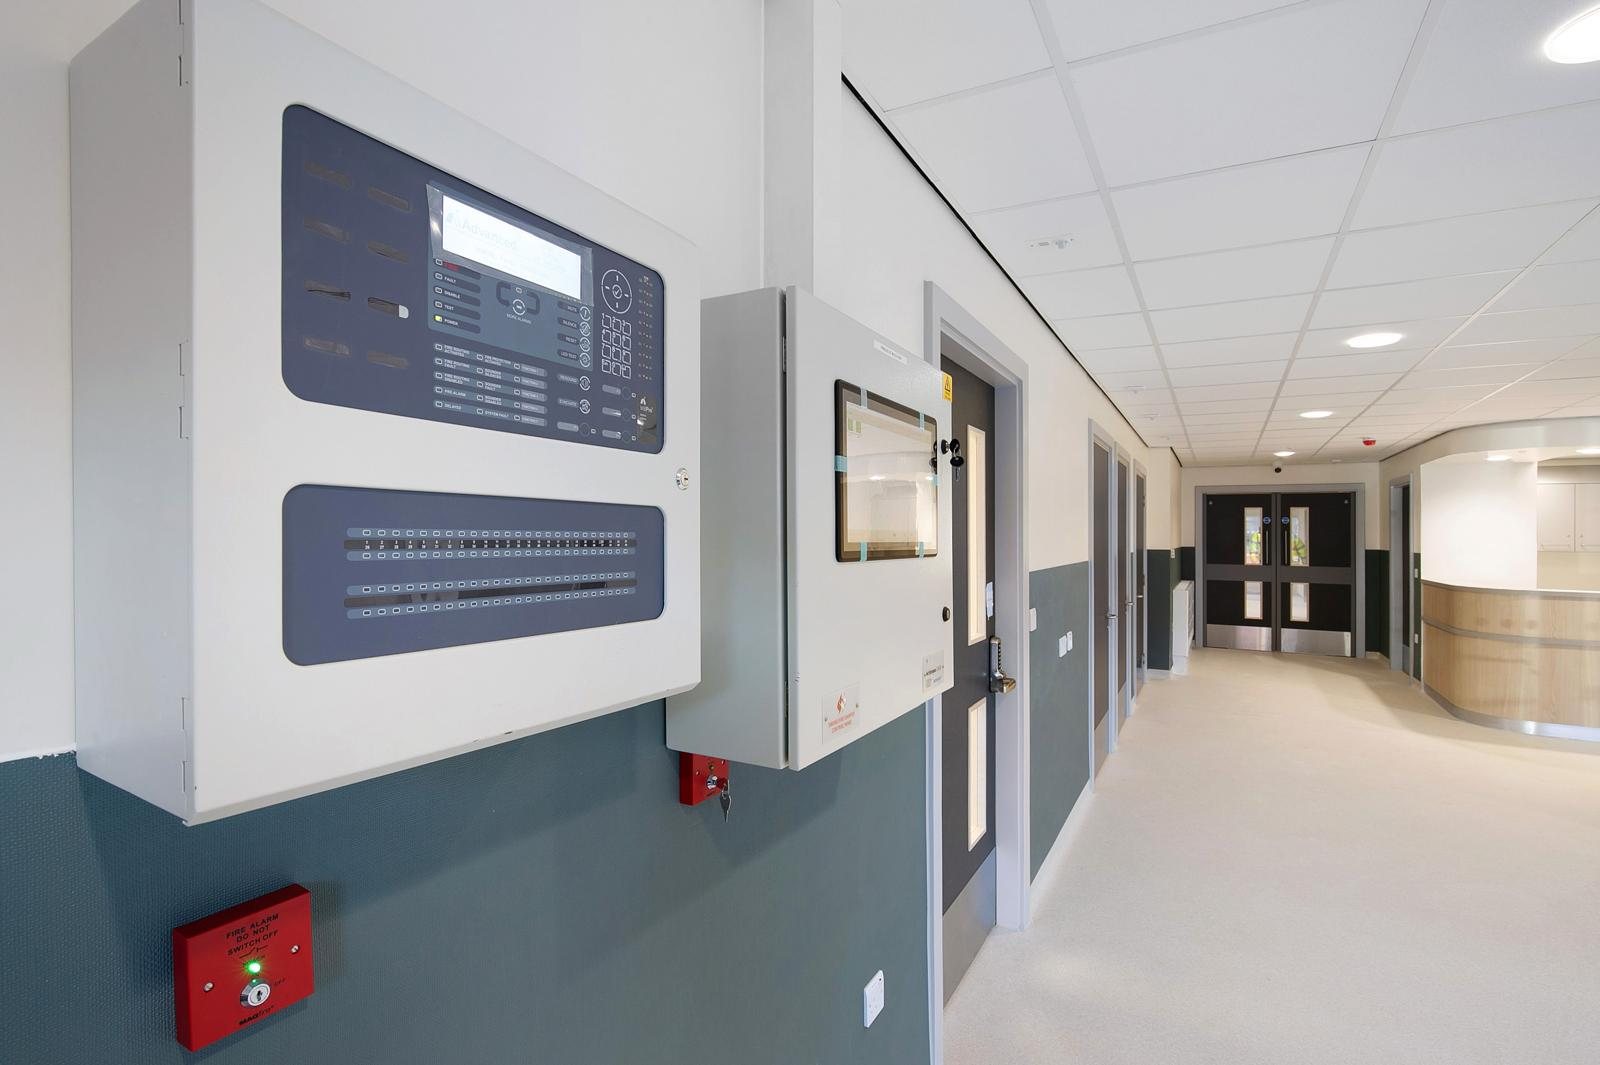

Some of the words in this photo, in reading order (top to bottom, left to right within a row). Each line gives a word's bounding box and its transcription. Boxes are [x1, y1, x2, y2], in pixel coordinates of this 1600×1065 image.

[226, 926, 247, 939] FIRE
[250, 913, 278, 929] ALARM
[237, 933, 249, 943] DO
[253, 924, 270, 935] NOT
[227, 937, 261, 955] SWITCH
[263, 930, 278, 941] OFF
